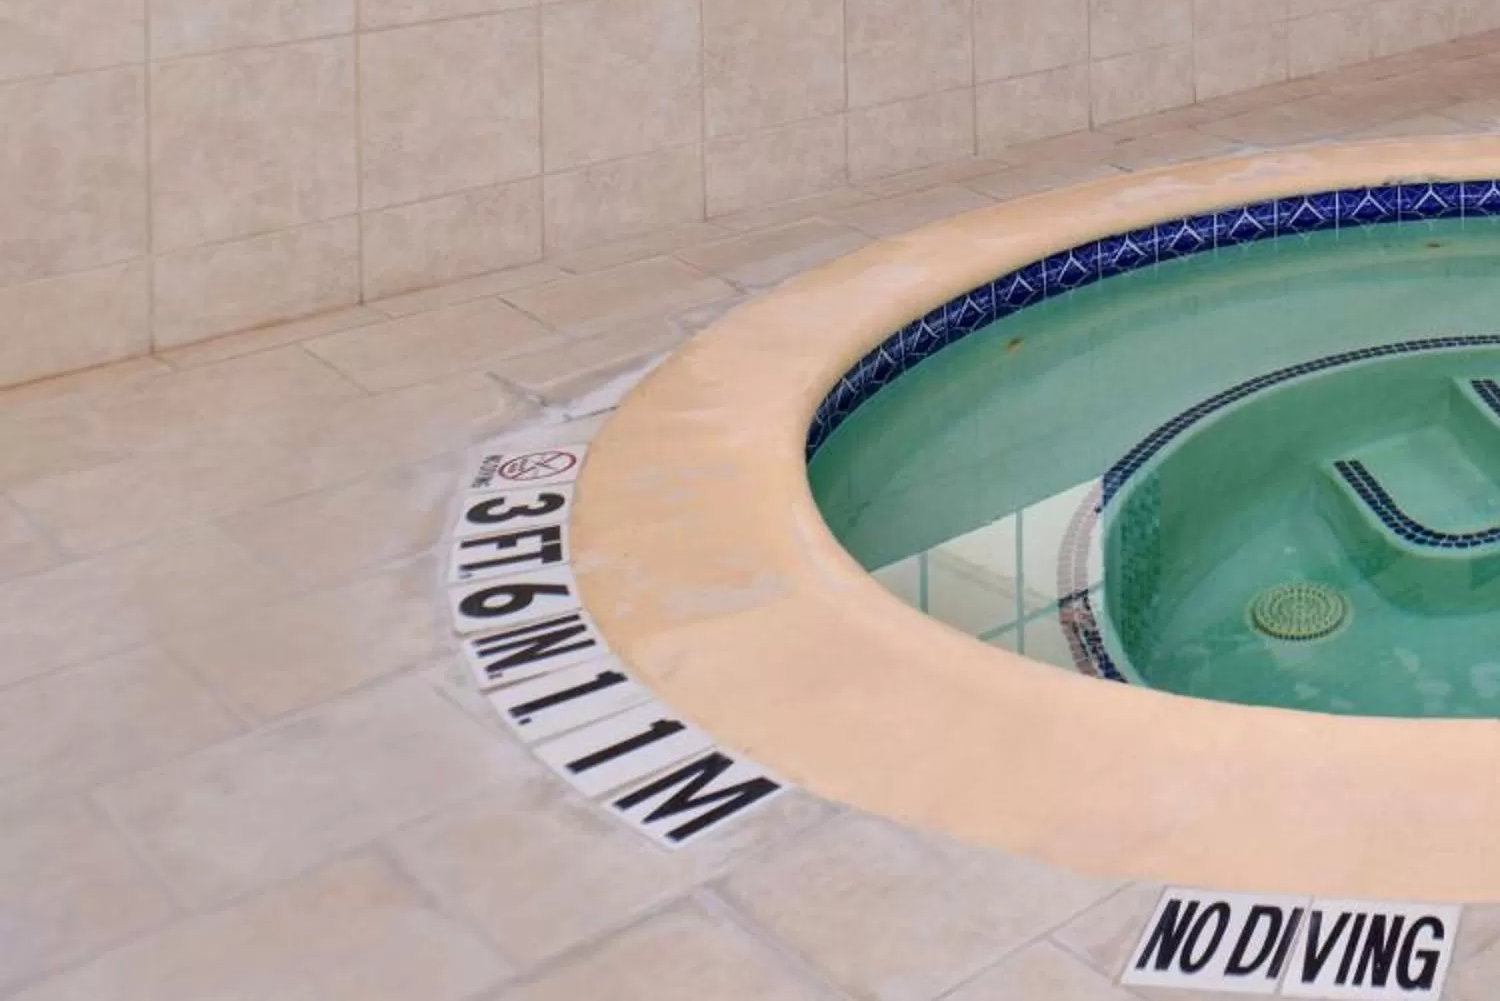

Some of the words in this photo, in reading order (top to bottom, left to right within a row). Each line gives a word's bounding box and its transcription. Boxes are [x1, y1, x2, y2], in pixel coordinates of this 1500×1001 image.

[465, 492, 565, 525] 3
[458, 583, 571, 618] 6
[612, 751, 784, 843] M
[1134, 898, 1232, 975] NO
[1223, 905, 1446, 992] DIVING
